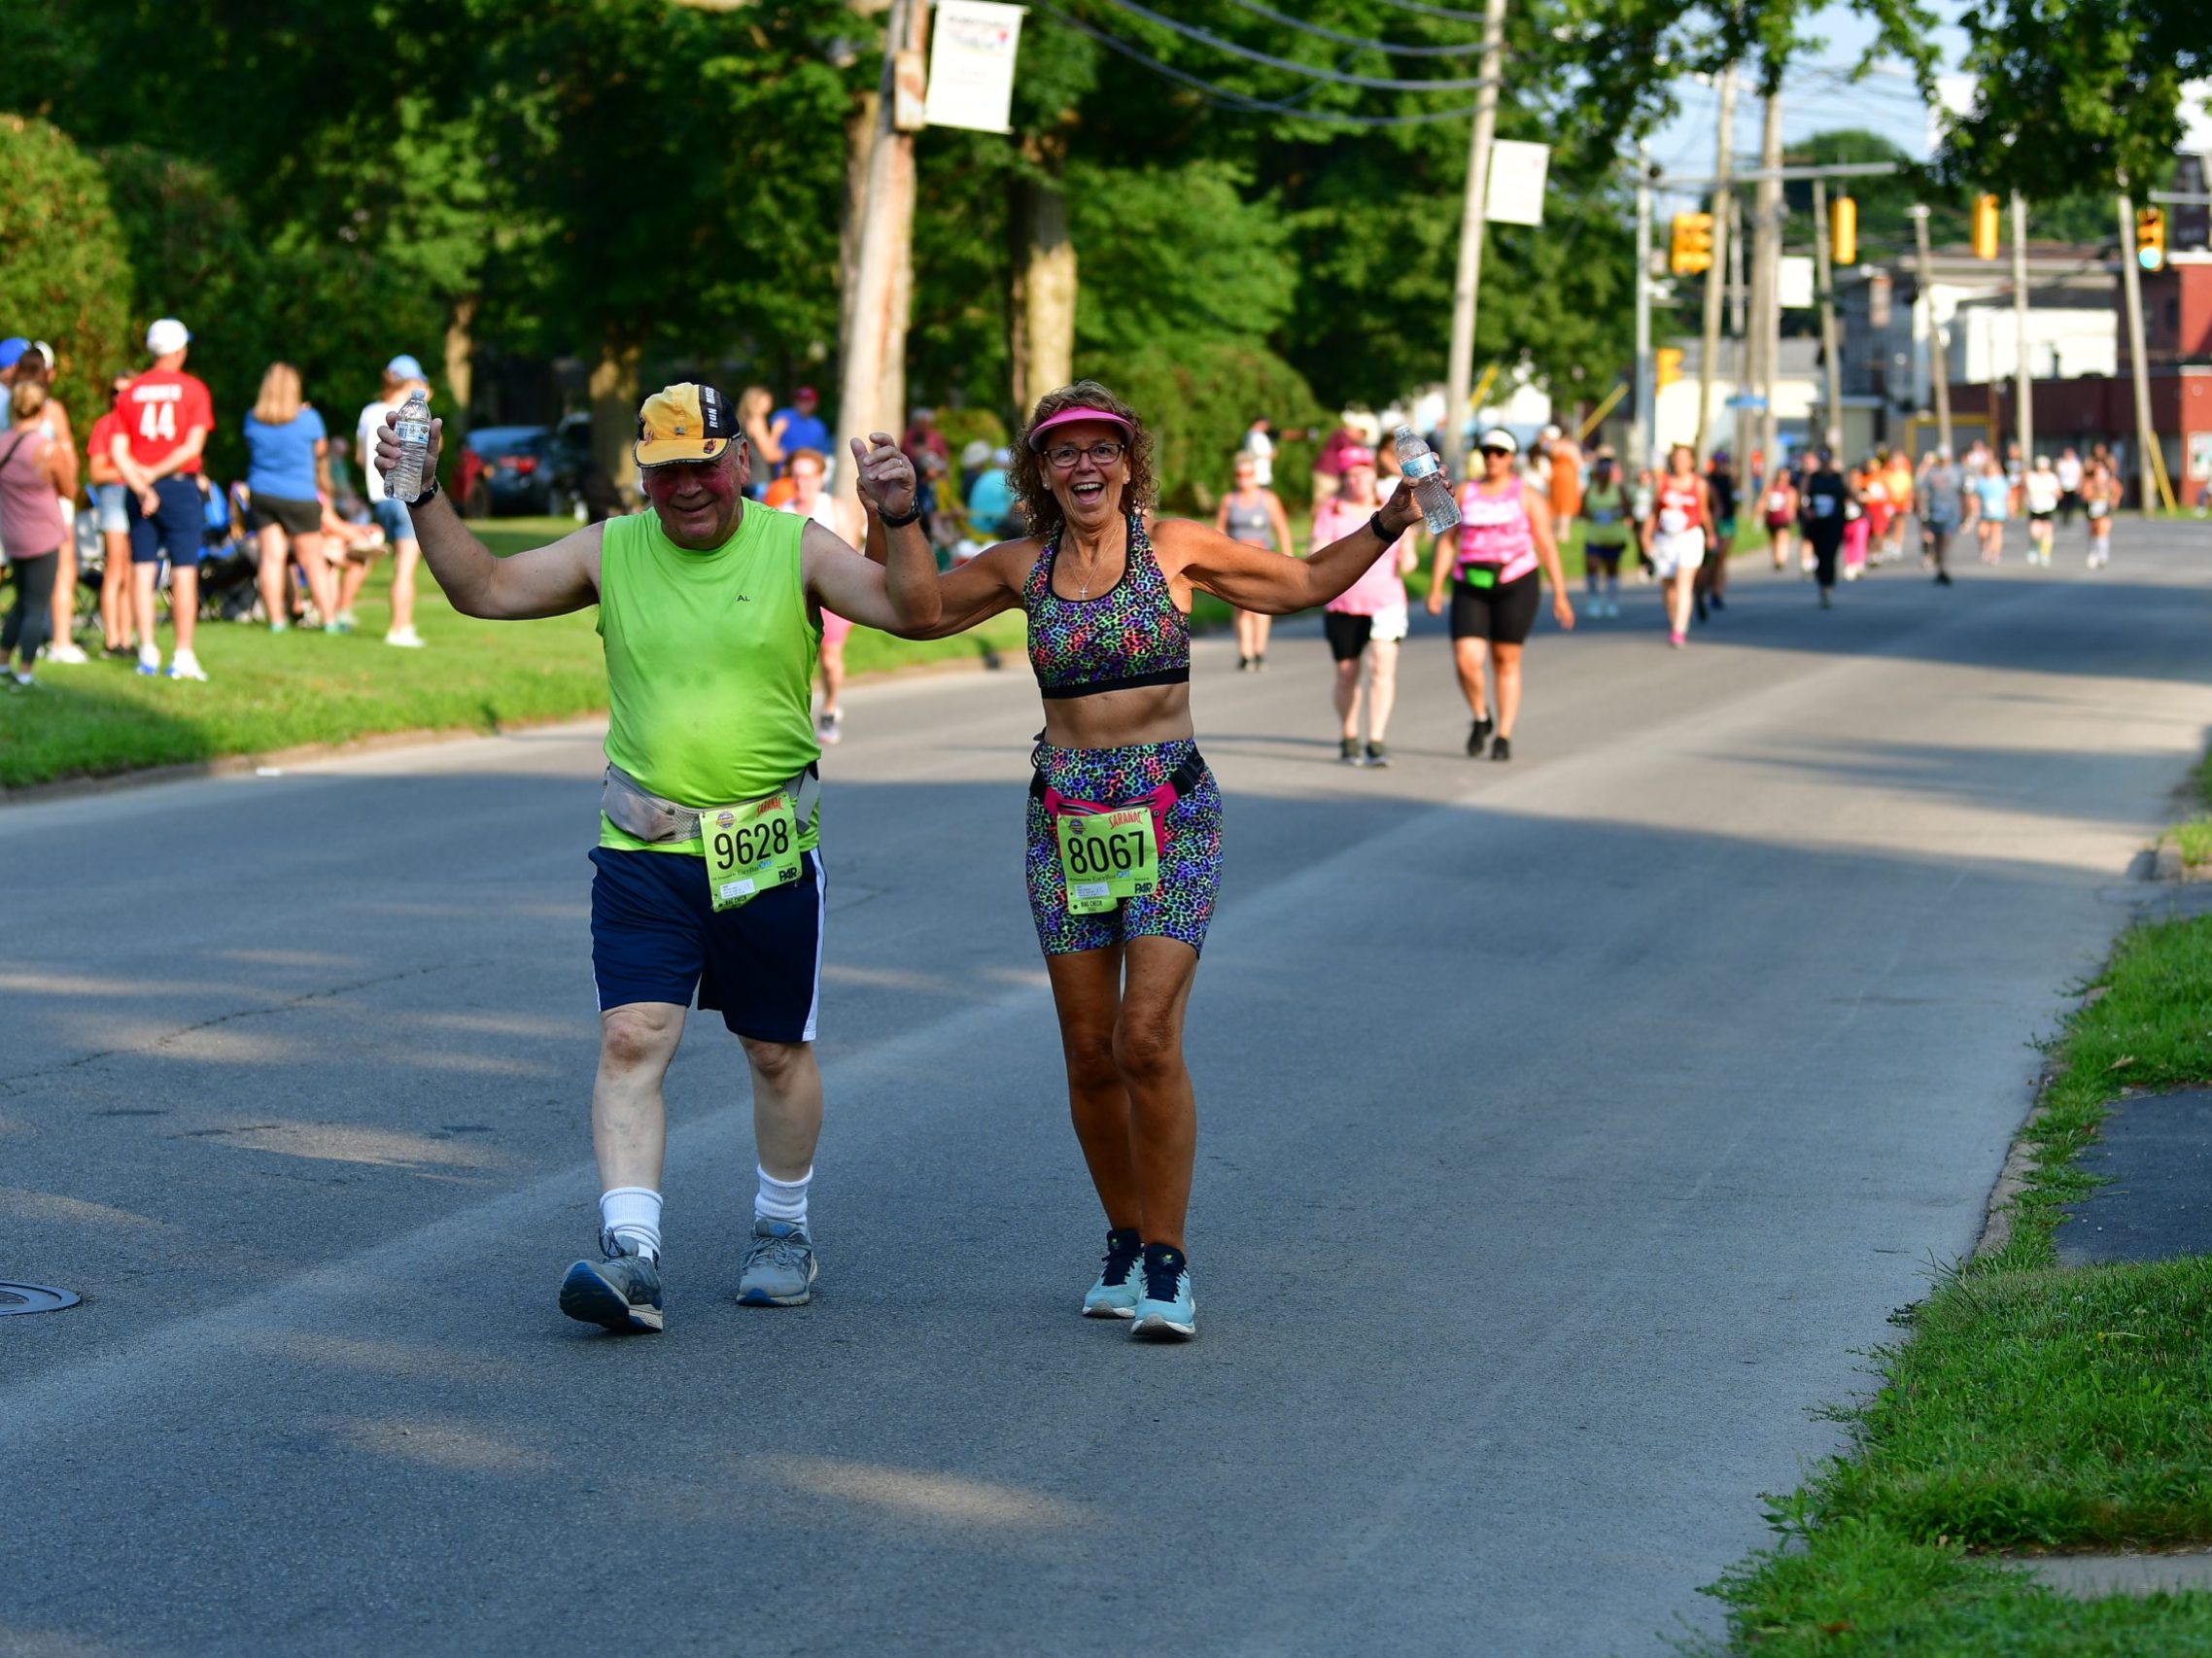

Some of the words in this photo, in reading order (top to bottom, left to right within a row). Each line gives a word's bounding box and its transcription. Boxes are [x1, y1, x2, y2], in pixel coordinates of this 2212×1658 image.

[139, 402, 177, 442] 44
[709, 408, 719, 428] RUN
[1109, 812, 1143, 829] SARANAC
[713, 818, 789, 871] 9628
[1067, 831, 1145, 875] 8067
